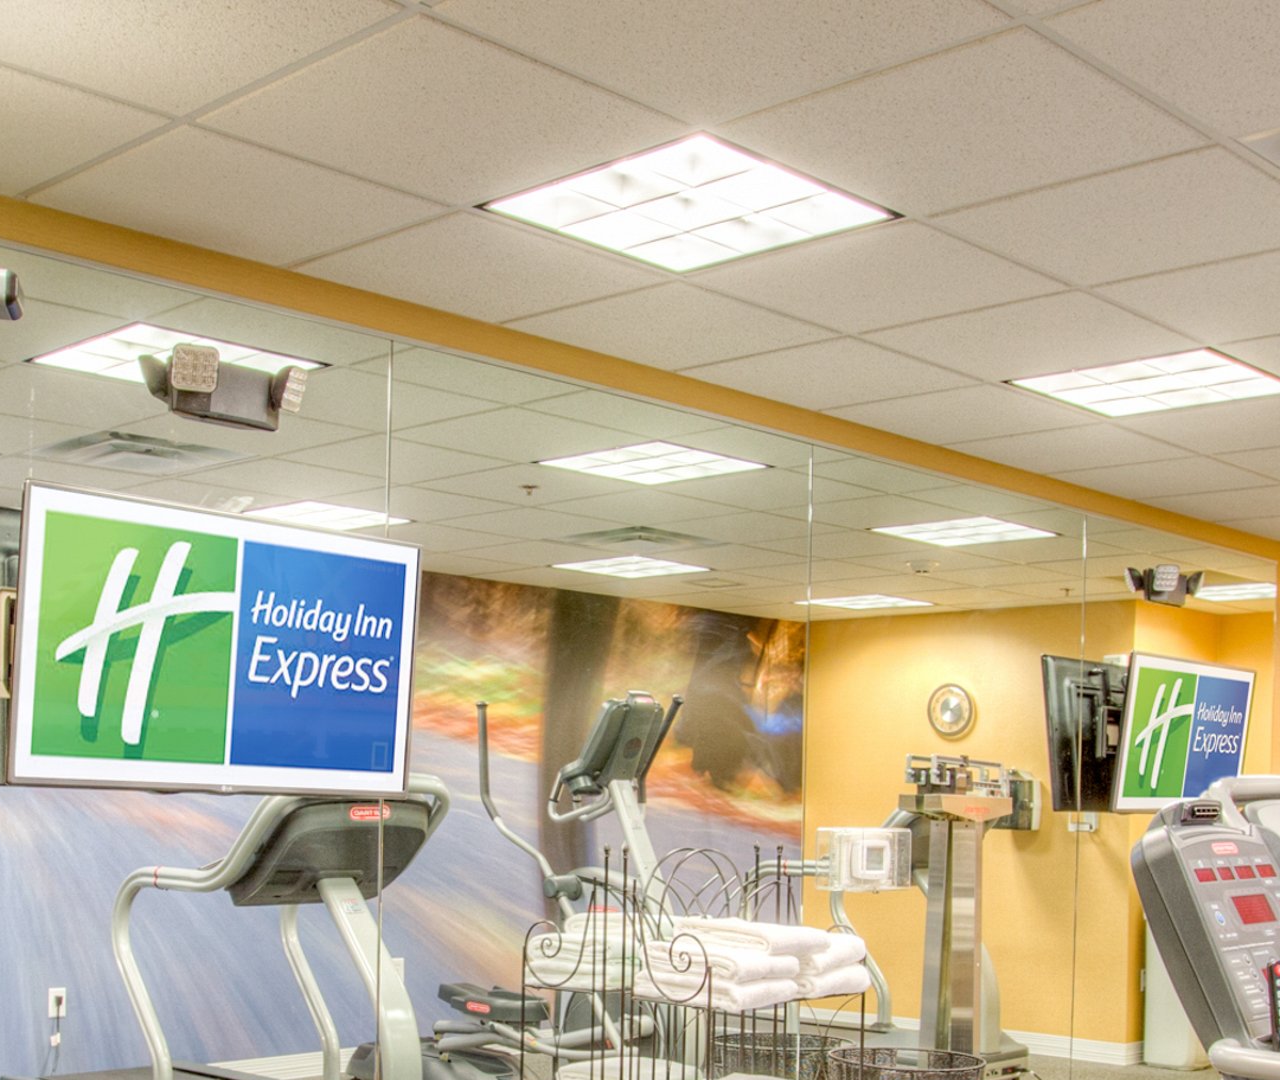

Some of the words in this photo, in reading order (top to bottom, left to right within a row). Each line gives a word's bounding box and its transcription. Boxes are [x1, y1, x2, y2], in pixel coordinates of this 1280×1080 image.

[251, 590, 352, 642] Holiday
[354, 604, 393, 640] Inn
[248, 635, 391, 699] Express
[1197, 702, 1231, 728] Holiday
[1228, 705, 1243, 724] Inn
[1193, 726, 1240, 760] Express
